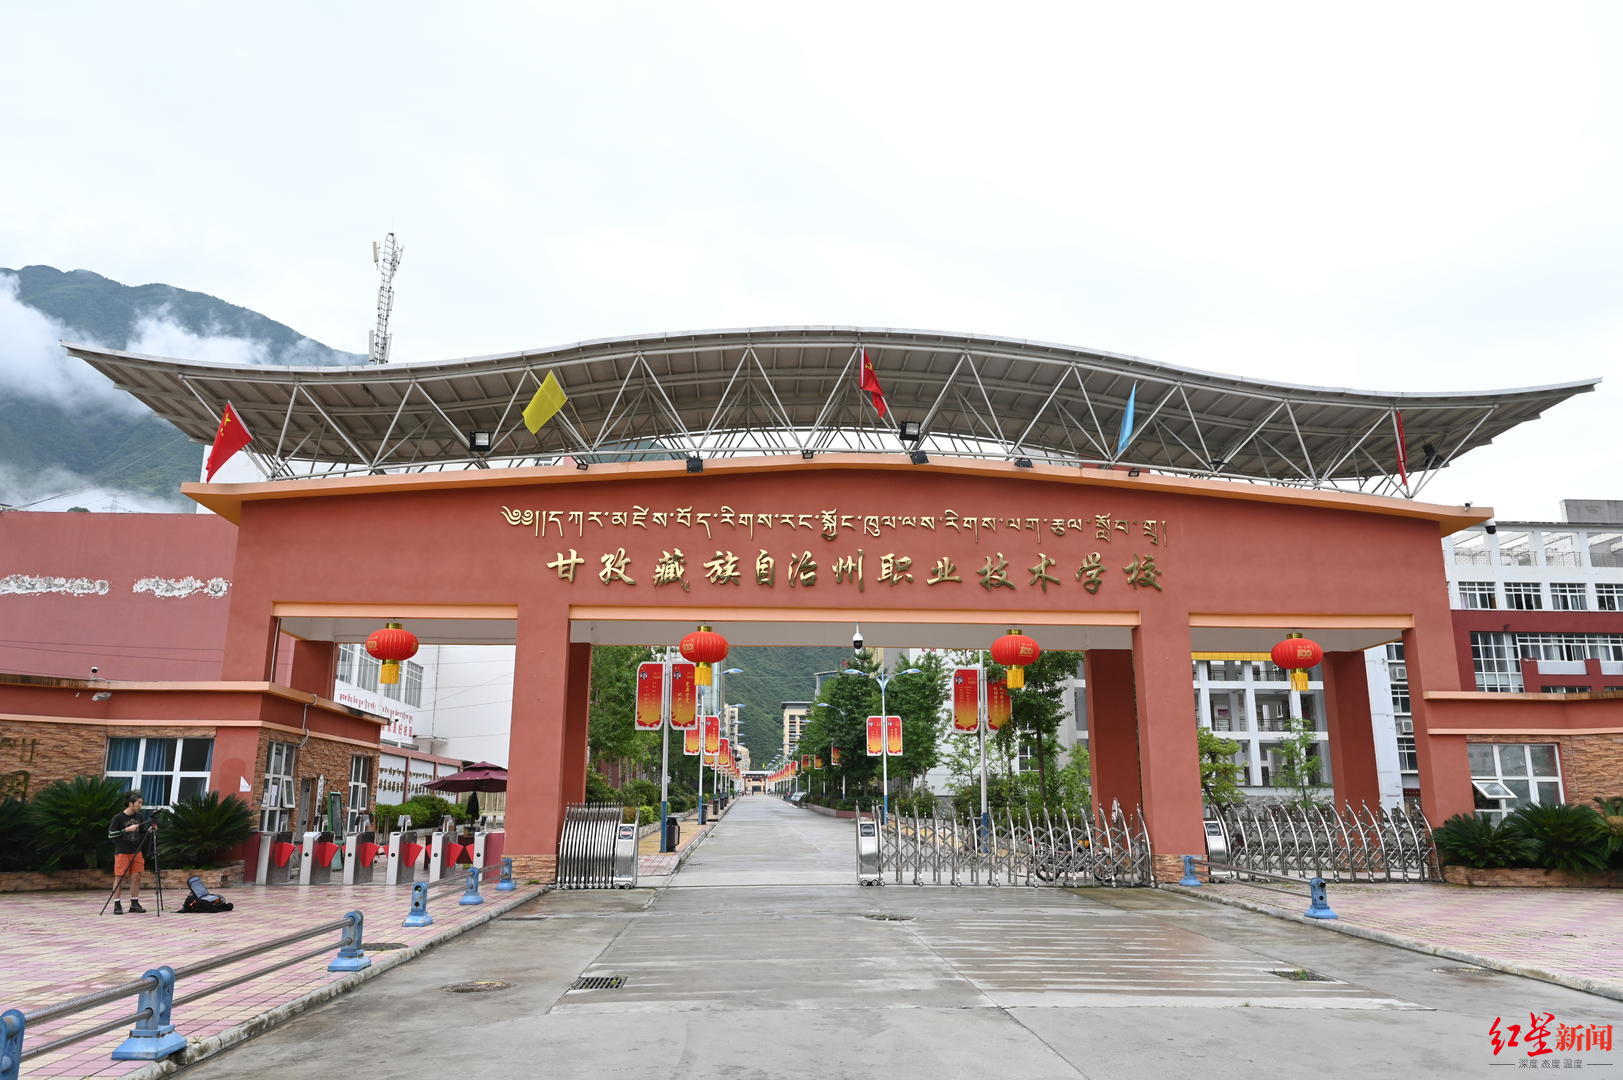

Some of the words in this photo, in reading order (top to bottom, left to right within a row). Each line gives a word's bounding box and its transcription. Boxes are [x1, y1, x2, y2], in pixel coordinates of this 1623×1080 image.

[546, 547, 1163, 594] 甘孜藏族自治州职业技术学校
